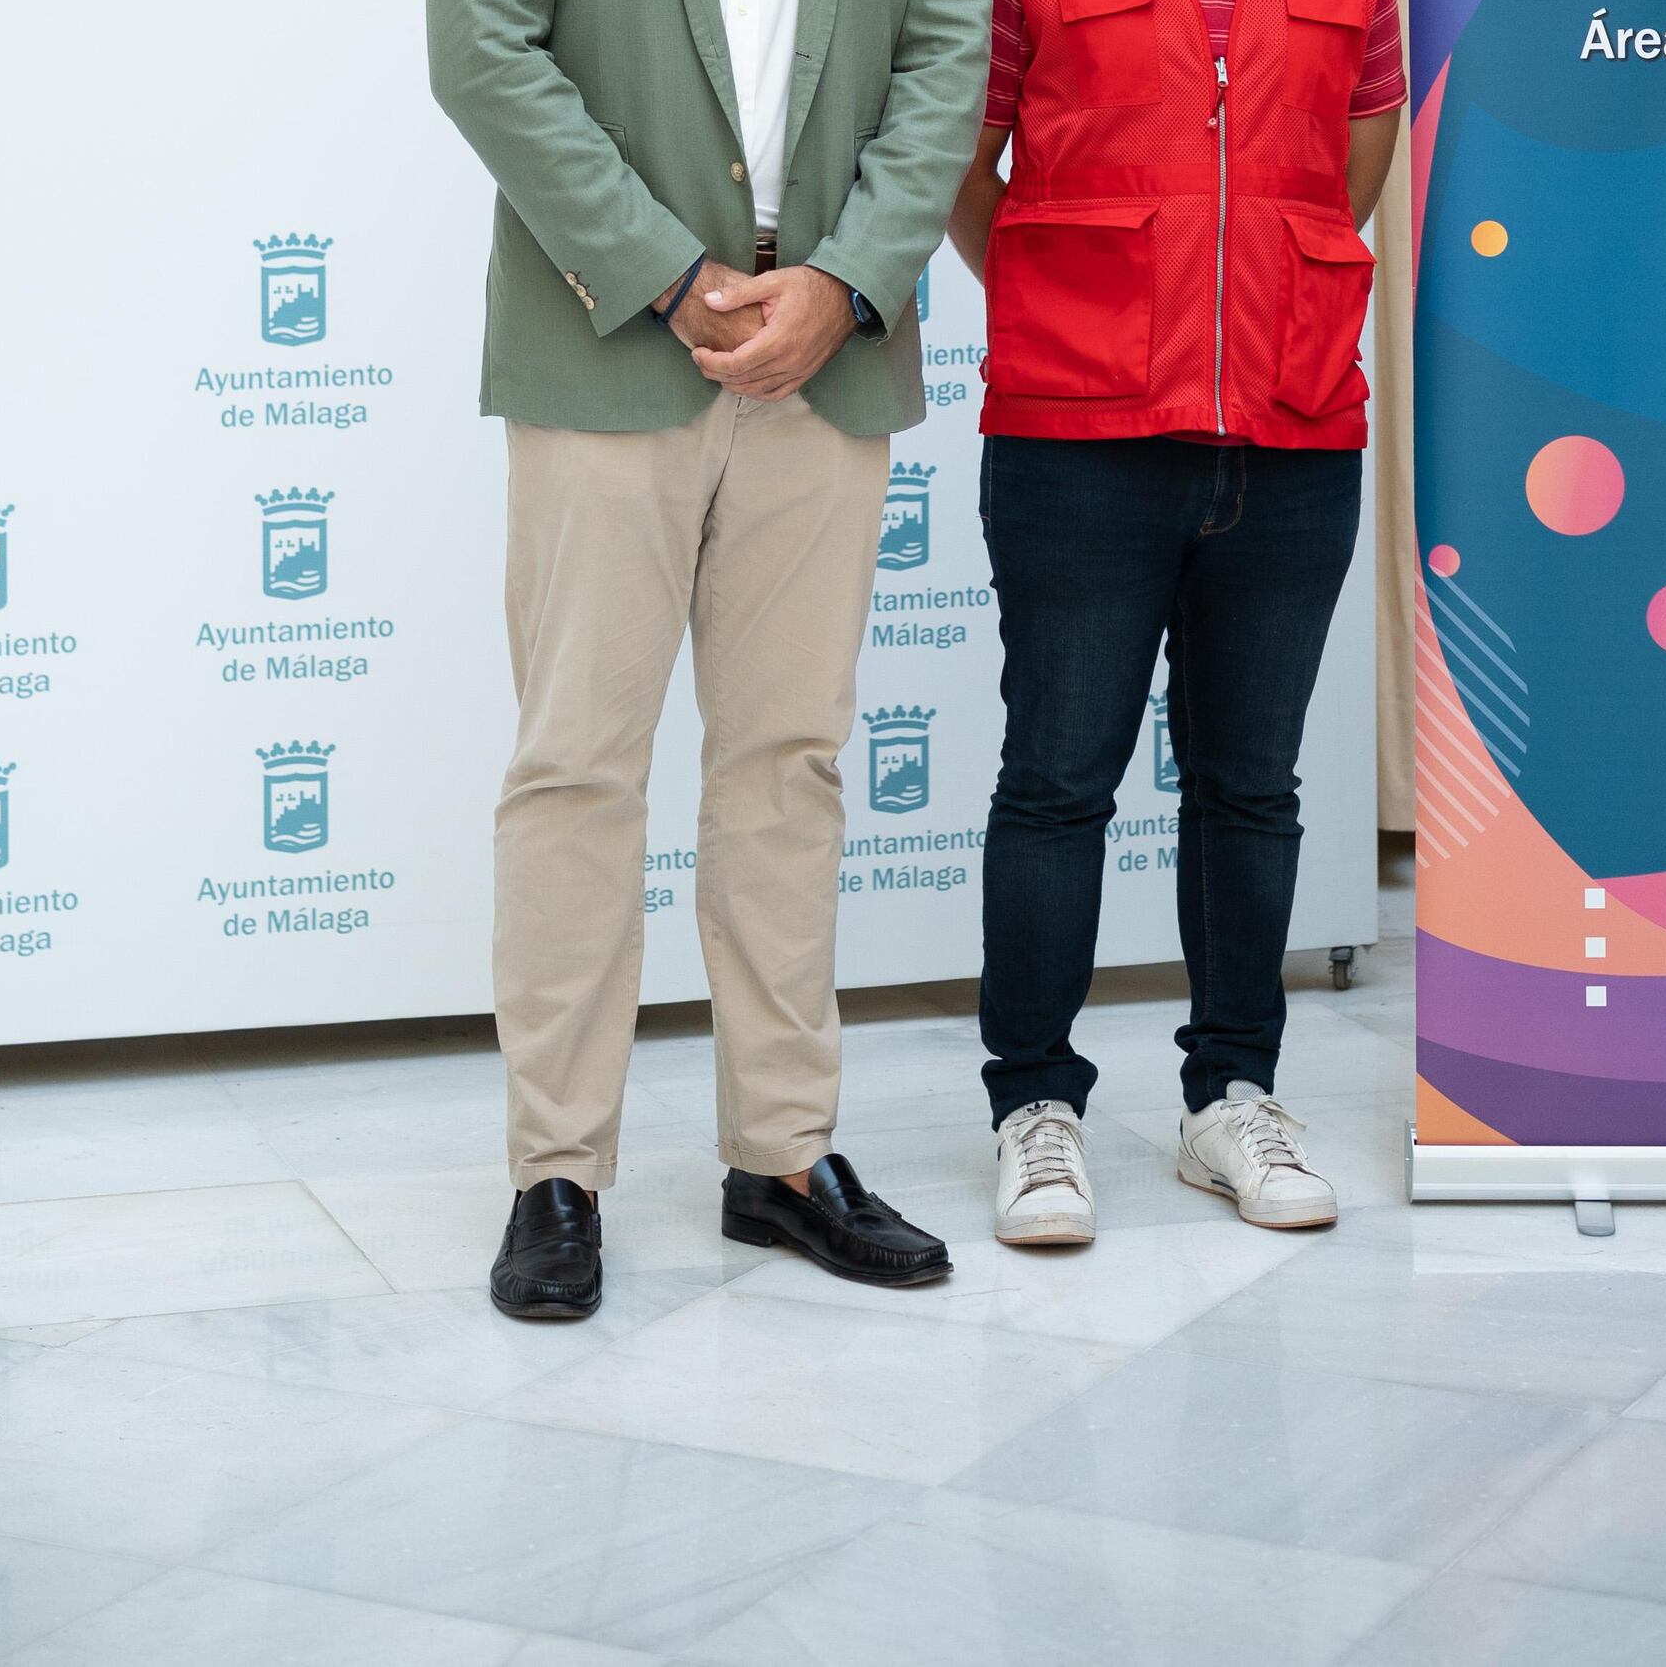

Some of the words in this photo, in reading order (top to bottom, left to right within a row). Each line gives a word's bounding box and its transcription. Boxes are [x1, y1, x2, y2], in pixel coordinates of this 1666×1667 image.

[195, 364, 393, 396] Ayuntamiento
[221, 405, 254, 427] de
[265, 400, 367, 429] Málaga
[873, 586, 990, 612] tamiento
[196, 616, 394, 650] Ayuntamiento
[873, 622, 966, 649] Málaga
[222, 658, 255, 683] de
[267, 653, 368, 682] Málaga
[842, 828, 987, 857] untamiento
[1118, 850, 1148, 872] de
[197, 868, 395, 902] Ayuntamiento
[873, 865, 967, 891] Málaga
[223, 913, 256, 936] de
[268, 907, 369, 935] Málaga
